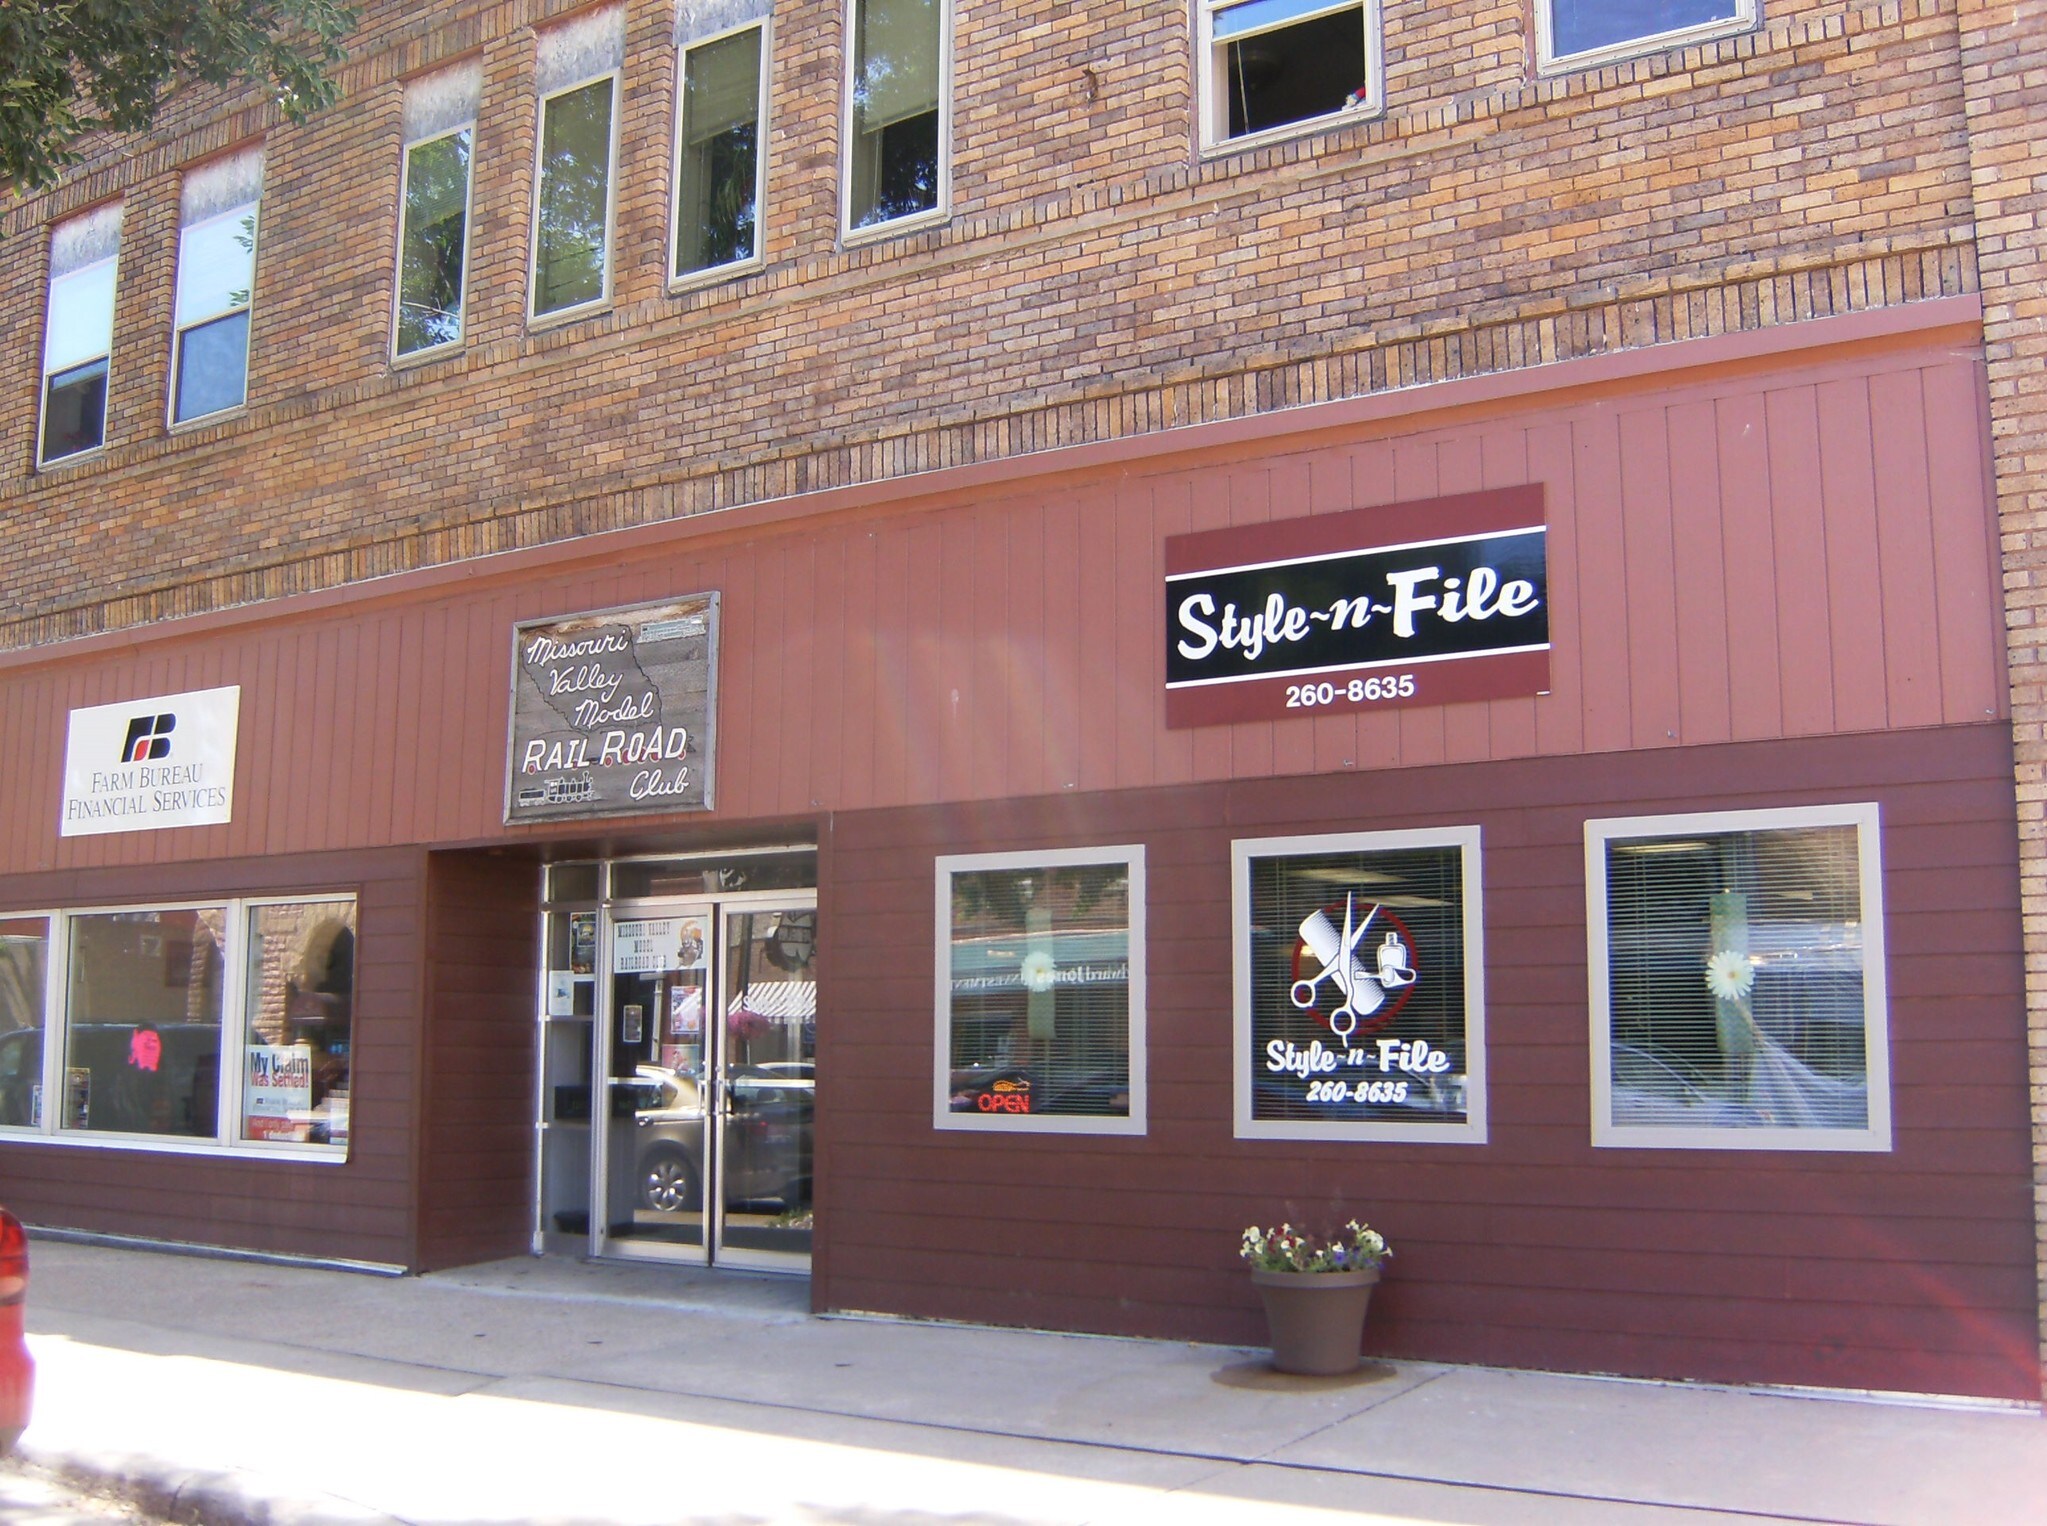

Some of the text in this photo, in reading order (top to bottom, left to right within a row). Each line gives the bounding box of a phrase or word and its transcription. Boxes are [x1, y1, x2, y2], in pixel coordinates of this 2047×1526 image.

[527, 630, 630, 666] Missouri
[550, 663, 624, 702] Valley
[1286, 674, 1415, 708] 260-8635
[575, 692, 654, 729] Model
[521, 726, 688, 774] RAIL ROAD
[91, 763, 204, 793] FARM BUREAU
[630, 766, 690, 800] Club
[68, 787, 226, 820] FINANCIAL SERVICES
[250, 1052, 268, 1076] My
[978, 1093, 1030, 1114] OPEN
[1306, 1081, 1408, 1102] 260-8635
